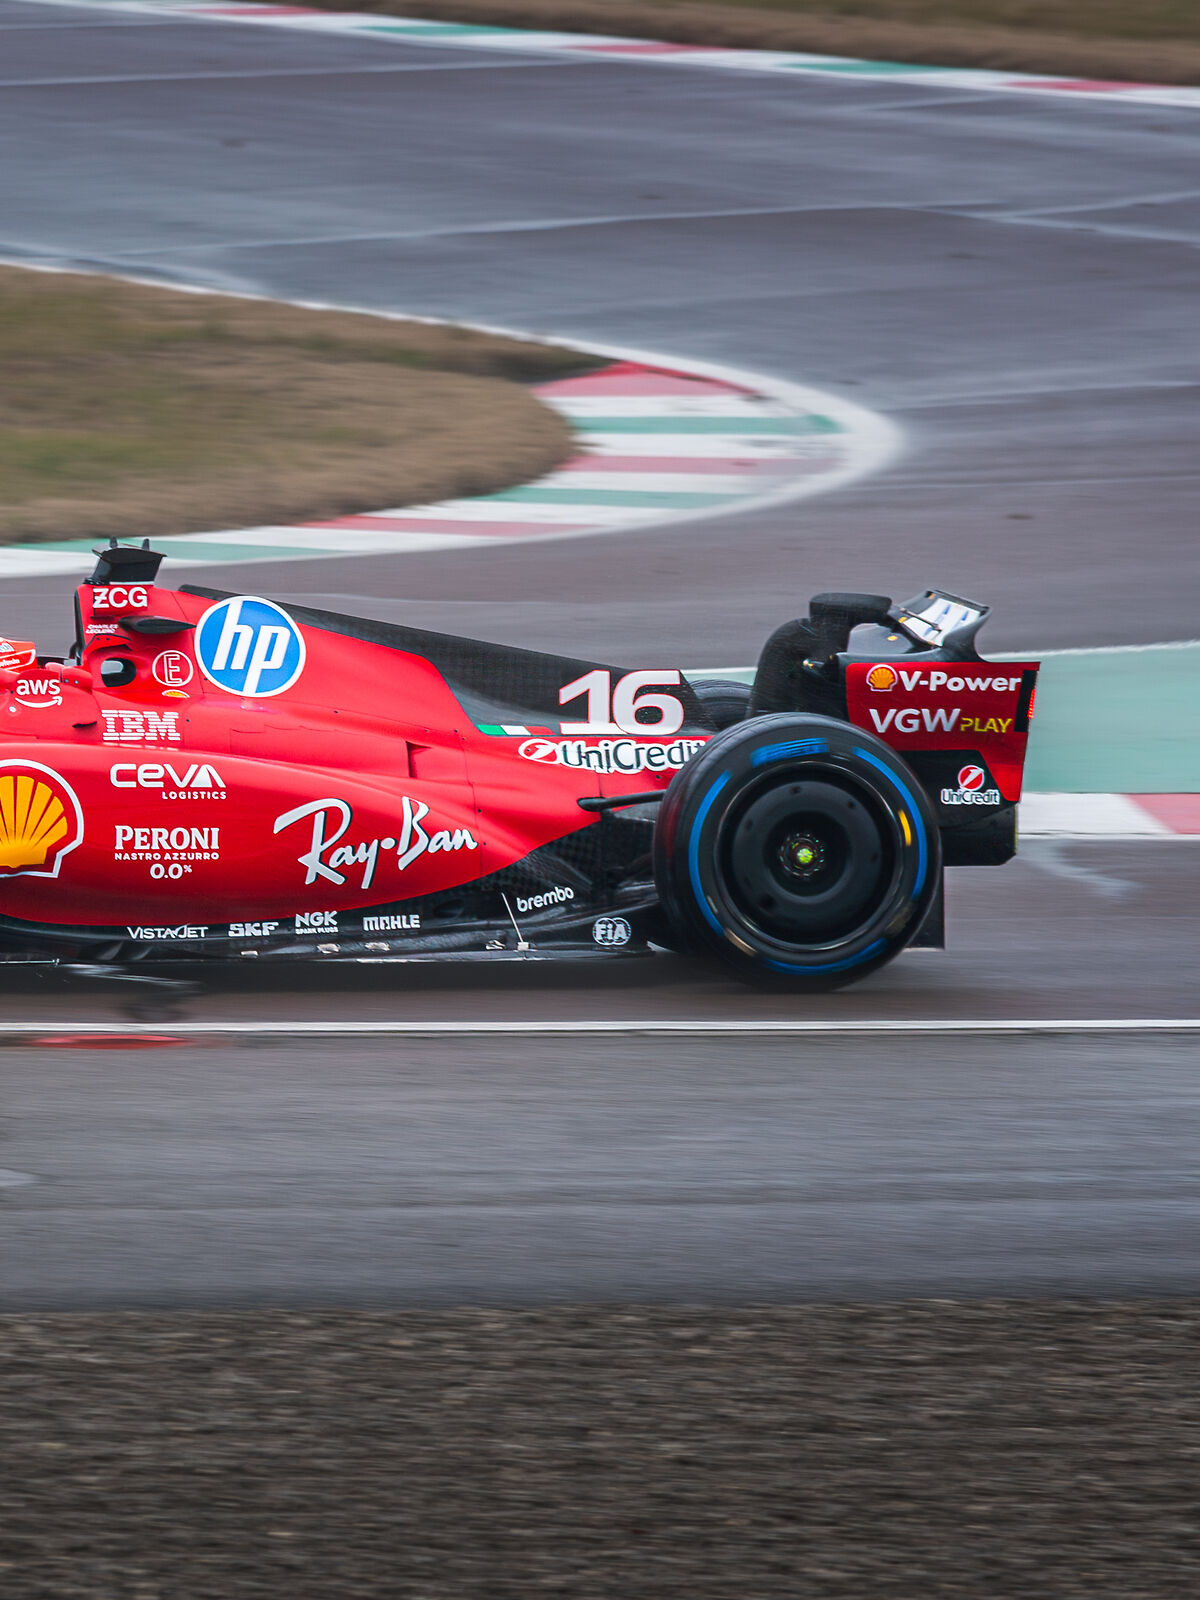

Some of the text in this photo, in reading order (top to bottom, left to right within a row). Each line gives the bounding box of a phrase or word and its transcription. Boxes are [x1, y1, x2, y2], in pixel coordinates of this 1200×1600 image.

[93, 587, 148, 608] ZCG
[211, 597, 291, 695] hp
[16, 679, 61, 696] aws
[899, 671, 1021, 692] V-Power
[559, 669, 684, 736] 16
[101, 710, 181, 741] IBM
[869, 708, 1013, 733] VGW PLAY
[560, 740, 702, 773] UniCredi
[162, 791, 227, 800] LOGISTICS
[941, 789, 1000, 804] UniCredit
[114, 825, 220, 850] PERONI
[114, 852, 220, 861] NASTRO AZZURRO
[149, 863, 193, 880] 0.0%
[516, 886, 574, 913] brembo
[228, 921, 280, 938] SKF
[294, 910, 338, 928] NGK
